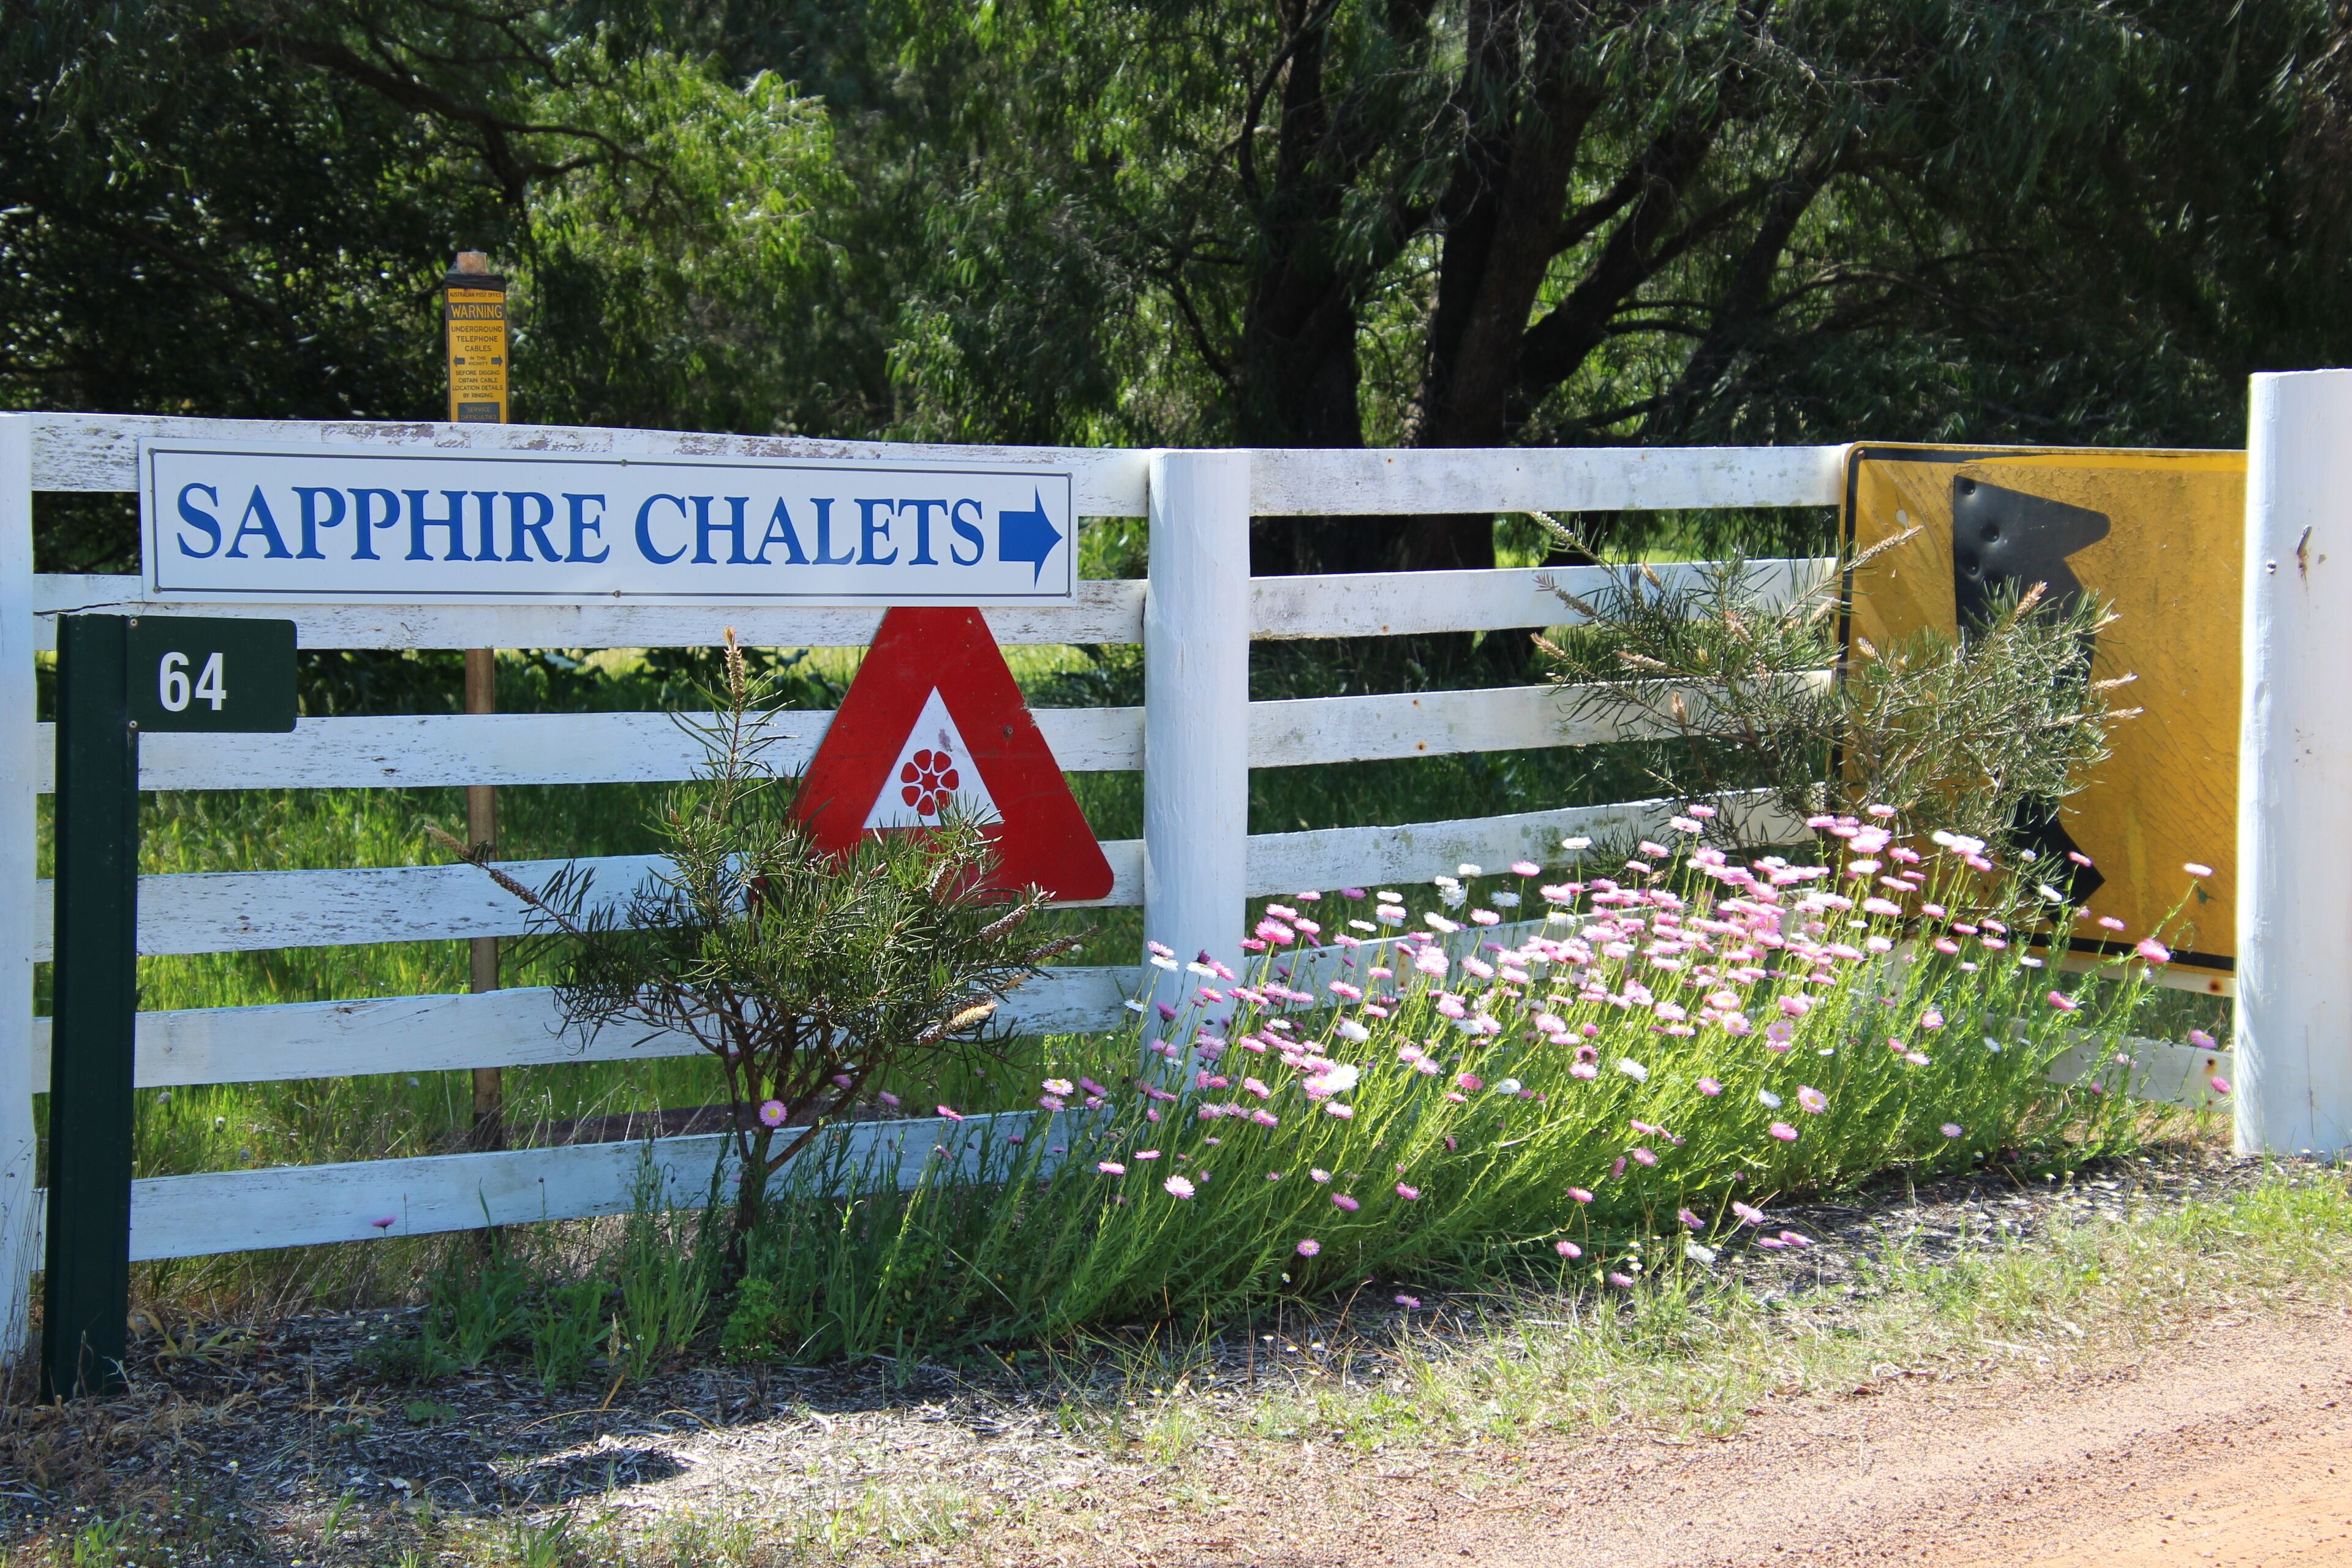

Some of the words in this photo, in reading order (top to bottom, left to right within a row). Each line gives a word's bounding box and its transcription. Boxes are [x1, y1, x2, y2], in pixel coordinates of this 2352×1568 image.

[451, 304, 502, 318] WARNING
[176, 483, 610, 564] SAPPHIRE
[635, 493, 984, 566] CHALETS
[159, 651, 227, 712] 64
